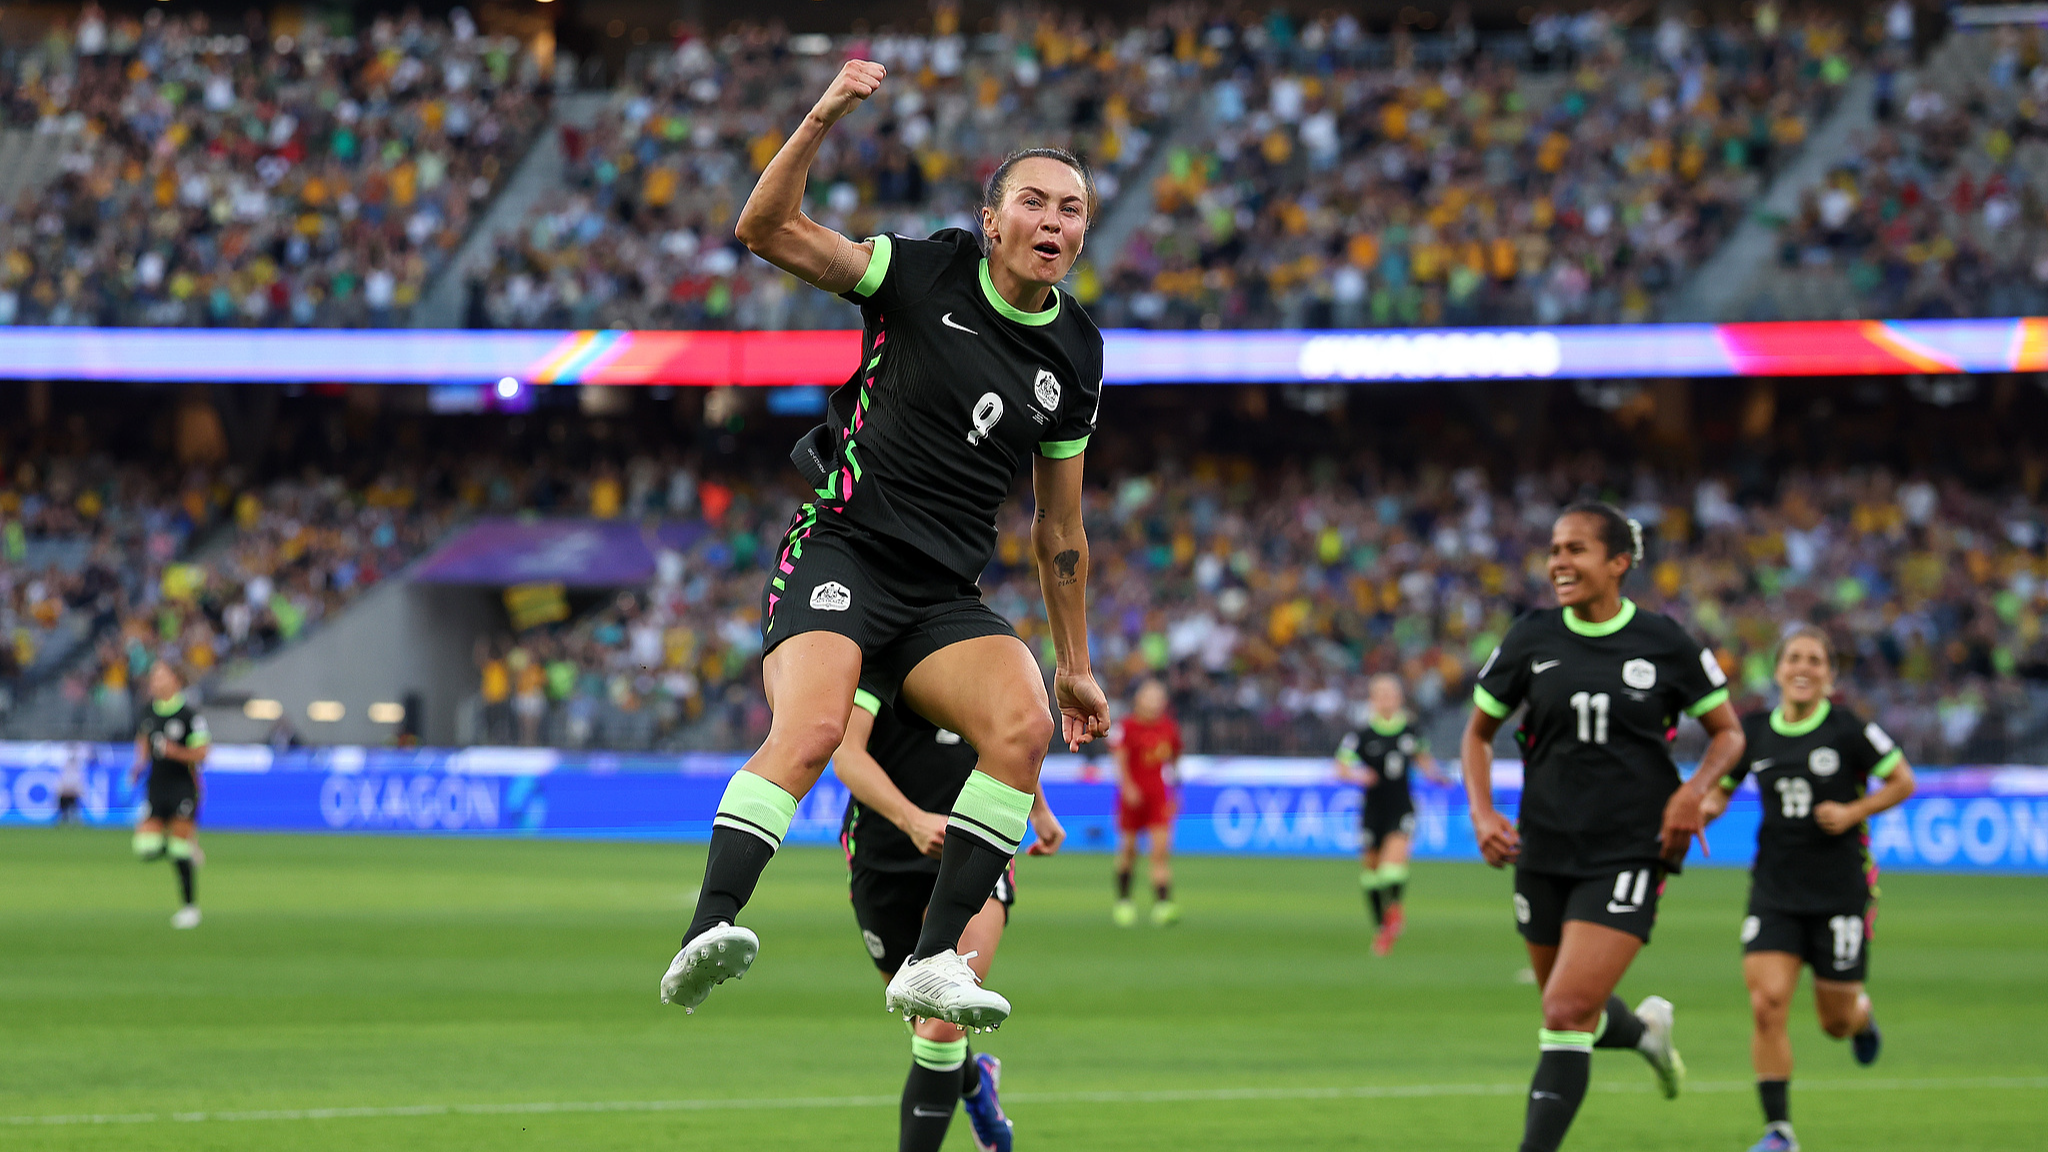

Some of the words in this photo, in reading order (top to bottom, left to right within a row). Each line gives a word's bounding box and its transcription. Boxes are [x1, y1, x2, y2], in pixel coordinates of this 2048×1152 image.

[1569, 691, 1610, 745] 11
[319, 773, 500, 830] OXAGON
[1212, 787, 1449, 850] OXAGN
[1774, 776, 1812, 818] 19
[1872, 798, 2048, 865] AGON
[1612, 869, 1650, 906] 11
